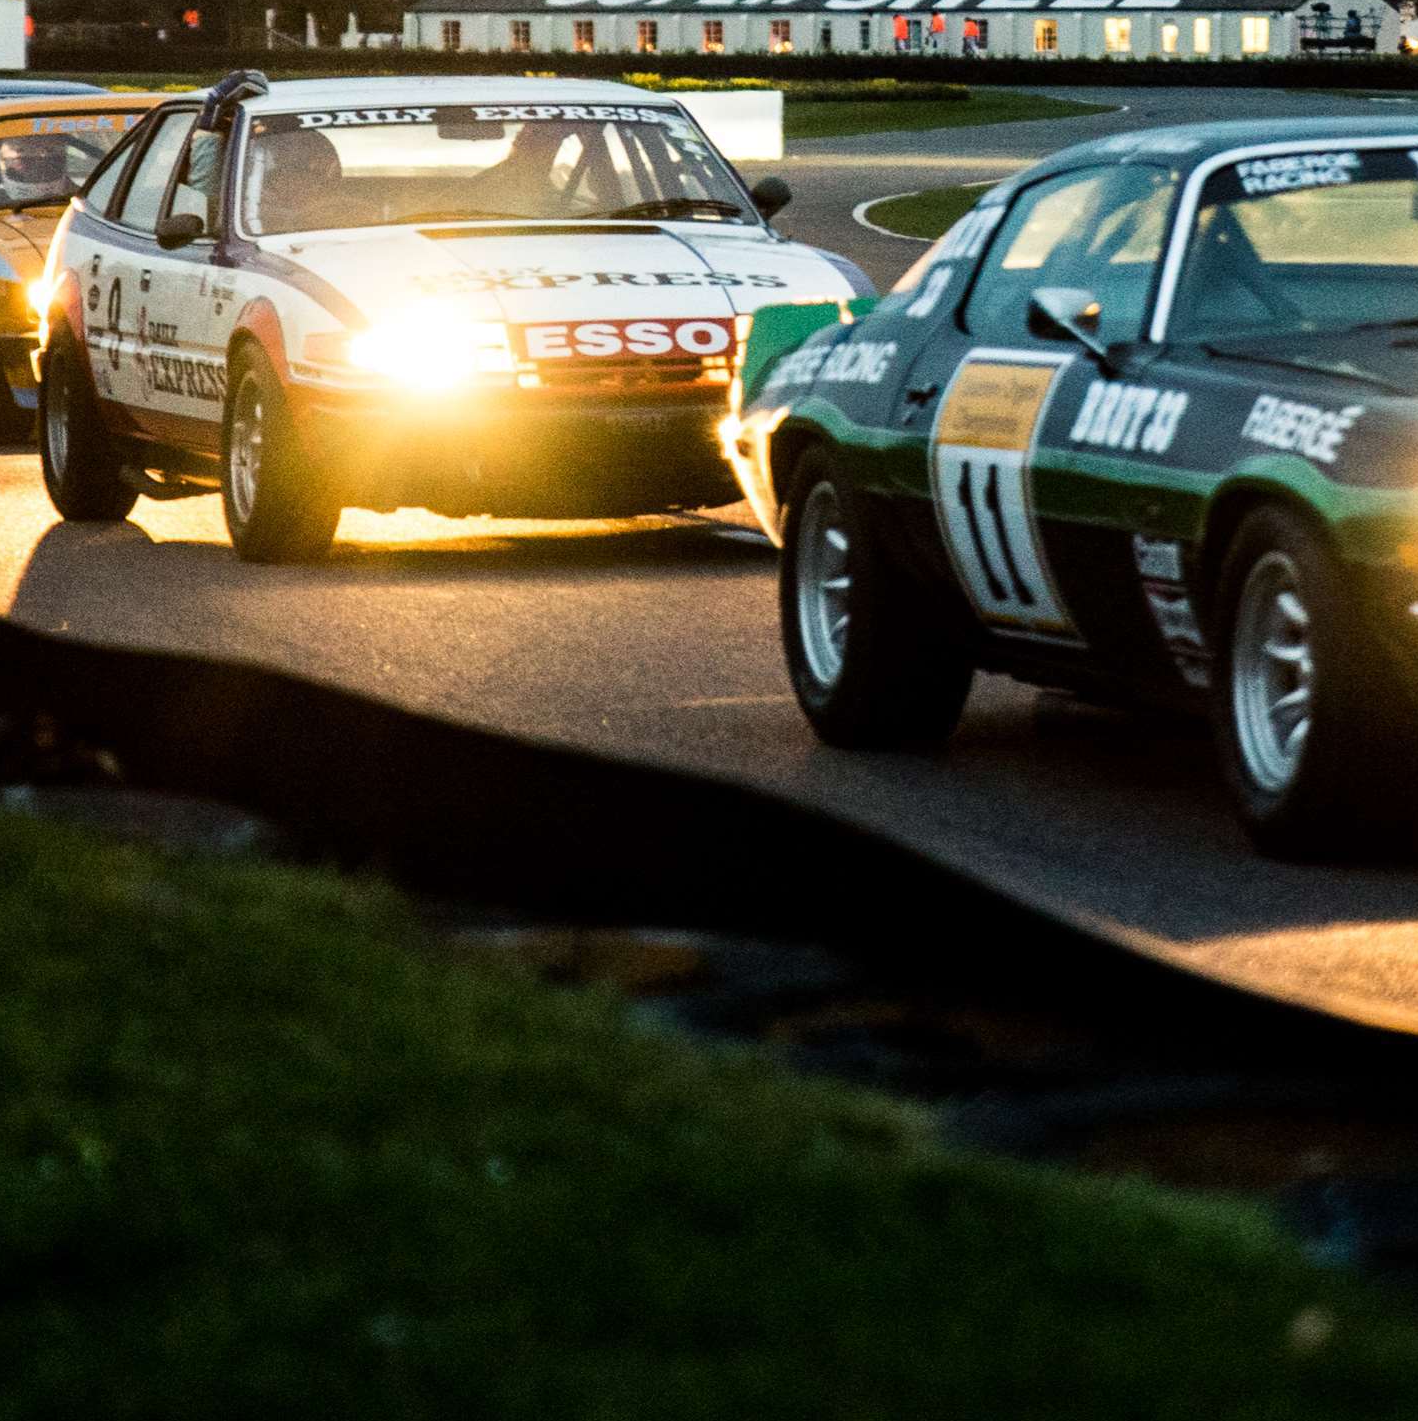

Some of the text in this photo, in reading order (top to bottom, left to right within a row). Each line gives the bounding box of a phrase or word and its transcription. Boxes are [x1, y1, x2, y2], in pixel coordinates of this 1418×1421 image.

[298, 106, 660, 129] DAILY EXPRESS
[524, 321, 731, 358] ESSO
[958, 460, 1036, 606] 11
